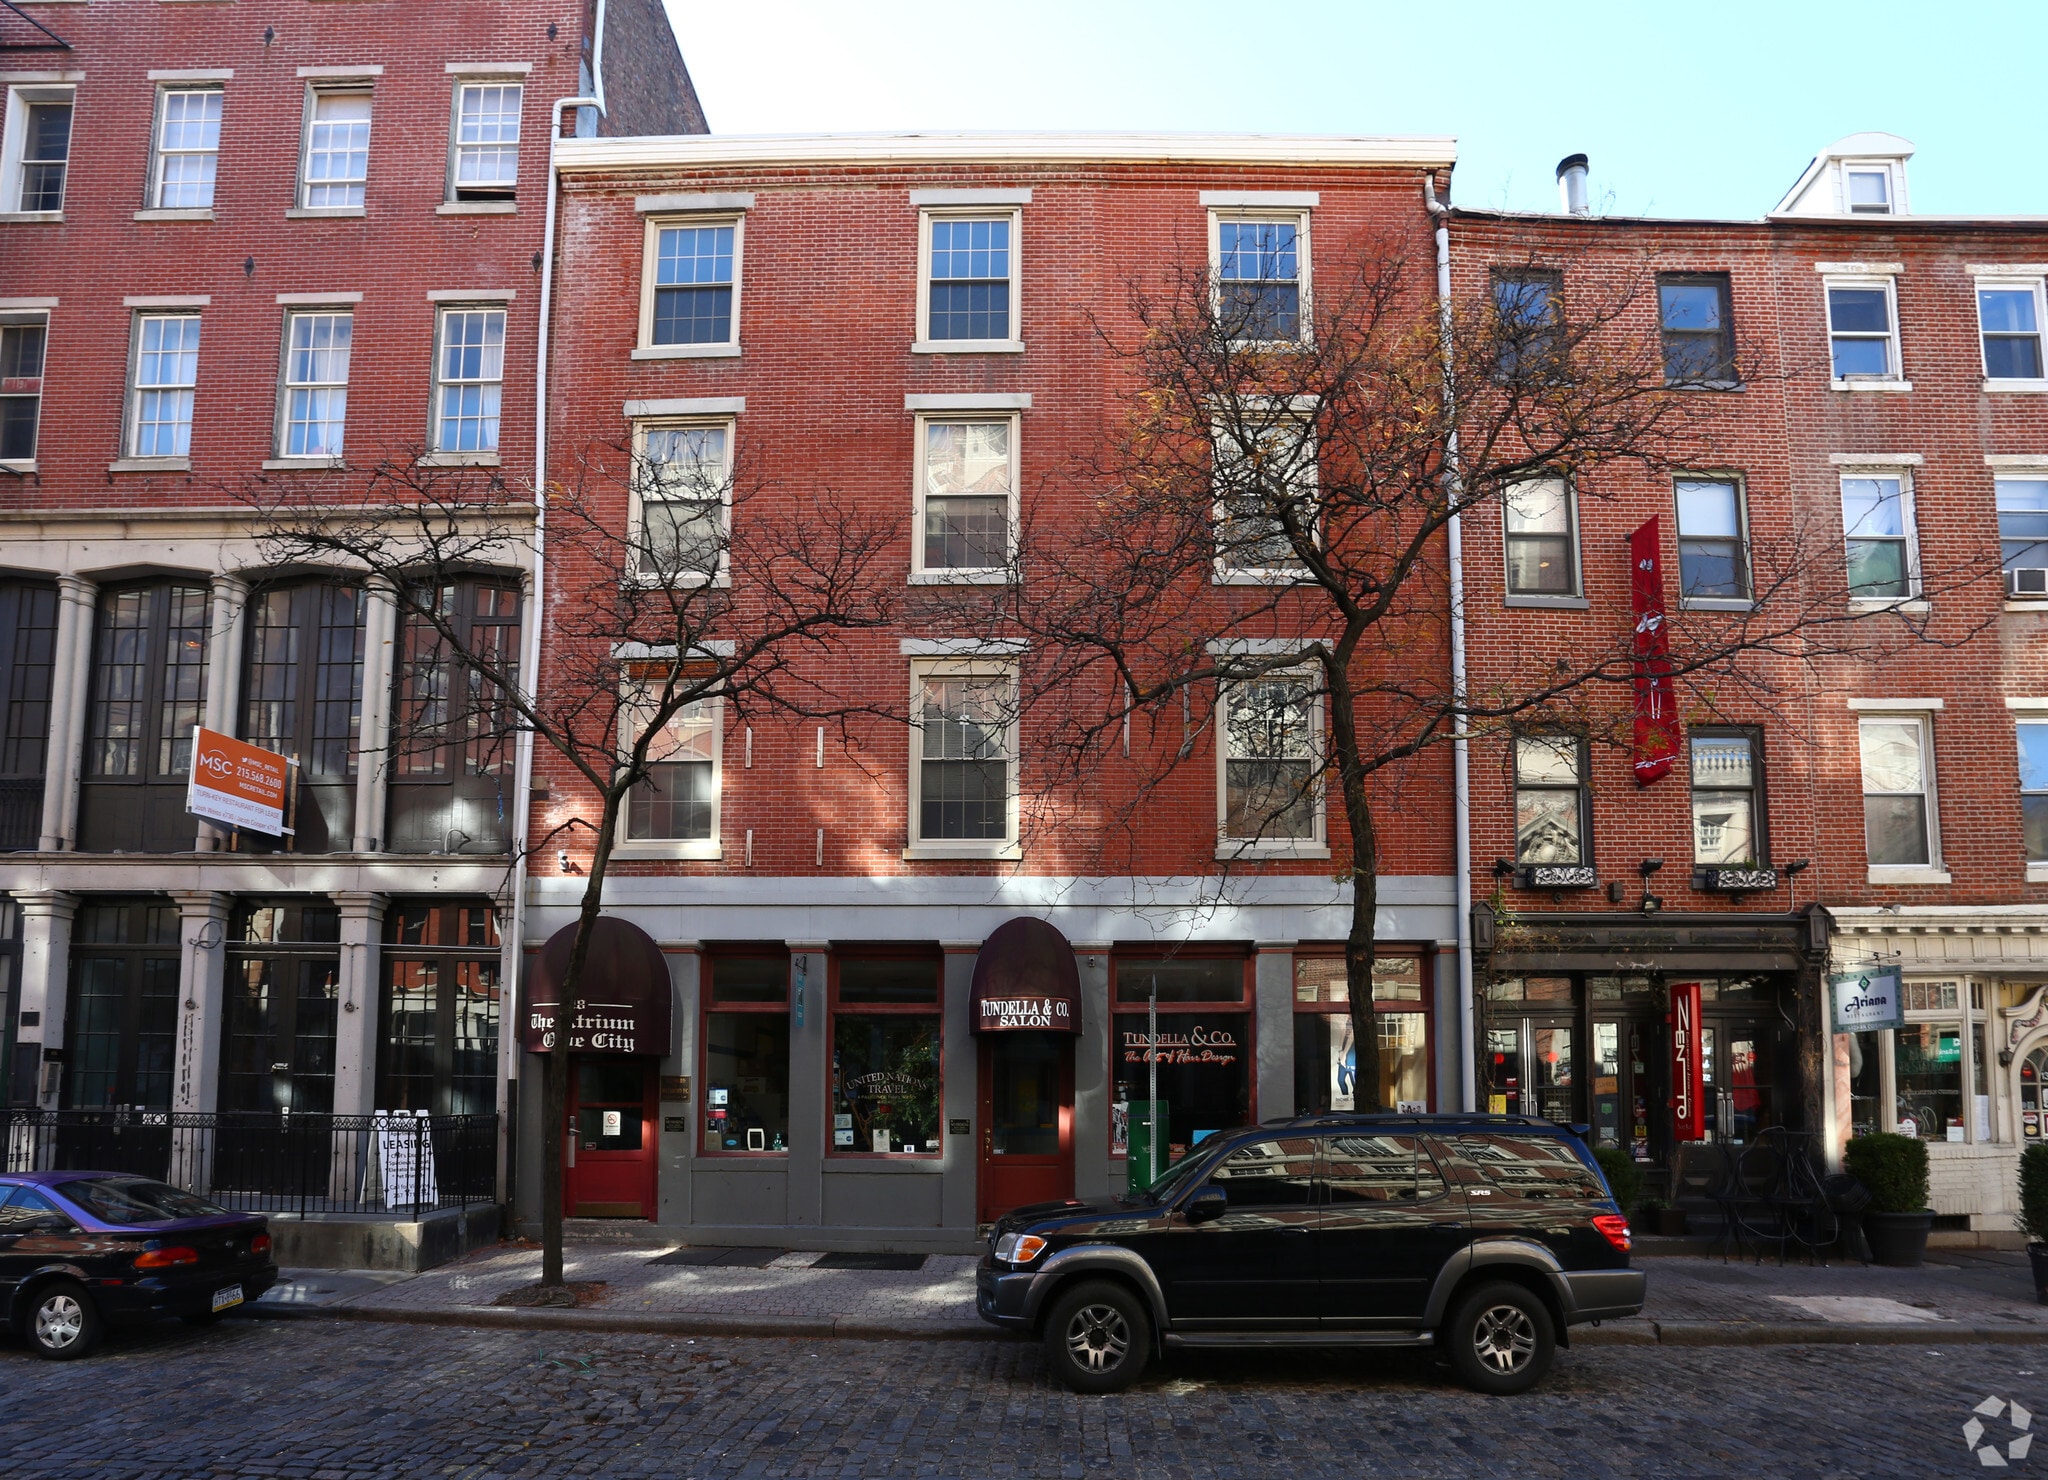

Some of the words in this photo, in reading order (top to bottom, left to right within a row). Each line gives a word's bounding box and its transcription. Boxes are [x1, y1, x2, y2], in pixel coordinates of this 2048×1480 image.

[200, 752, 233, 775] MSC
[236, 766, 282, 789] 215.568.2600
[239, 782, 278, 799] MSCRETAIL.COM
[196, 789, 221, 802] TURN-KEY
[222, 796, 255, 812] RESTAURANT
[255, 805, 265, 815] FOR
[265, 808, 279, 819] LEASE
[981, 1000, 1040, 1017] TUNDELLA
[1042, 998, 1053, 1016] &
[1056, 1002, 1069, 1017] CO.
[1844, 995, 1887, 1012] Ariana
[530, 1013, 555, 1032] The
[571, 1014, 635, 1030] trium
[1000, 1015, 1052, 1027] SALON
[1846, 1010, 1885, 1019] RESTAURANT
[591, 1032, 635, 1053] City
[1190, 1025, 1208, 1046] &
[1201, 1049, 1236, 1067] Design
[1675, 994, 1690, 1120] ZENTO
[846, 1071, 886, 1090] UNITED
[886, 1071, 928, 1090] NATIONS
[868, 1083, 907, 1094] TRAVEL
[383, 1139, 431, 1150] LEASIG
